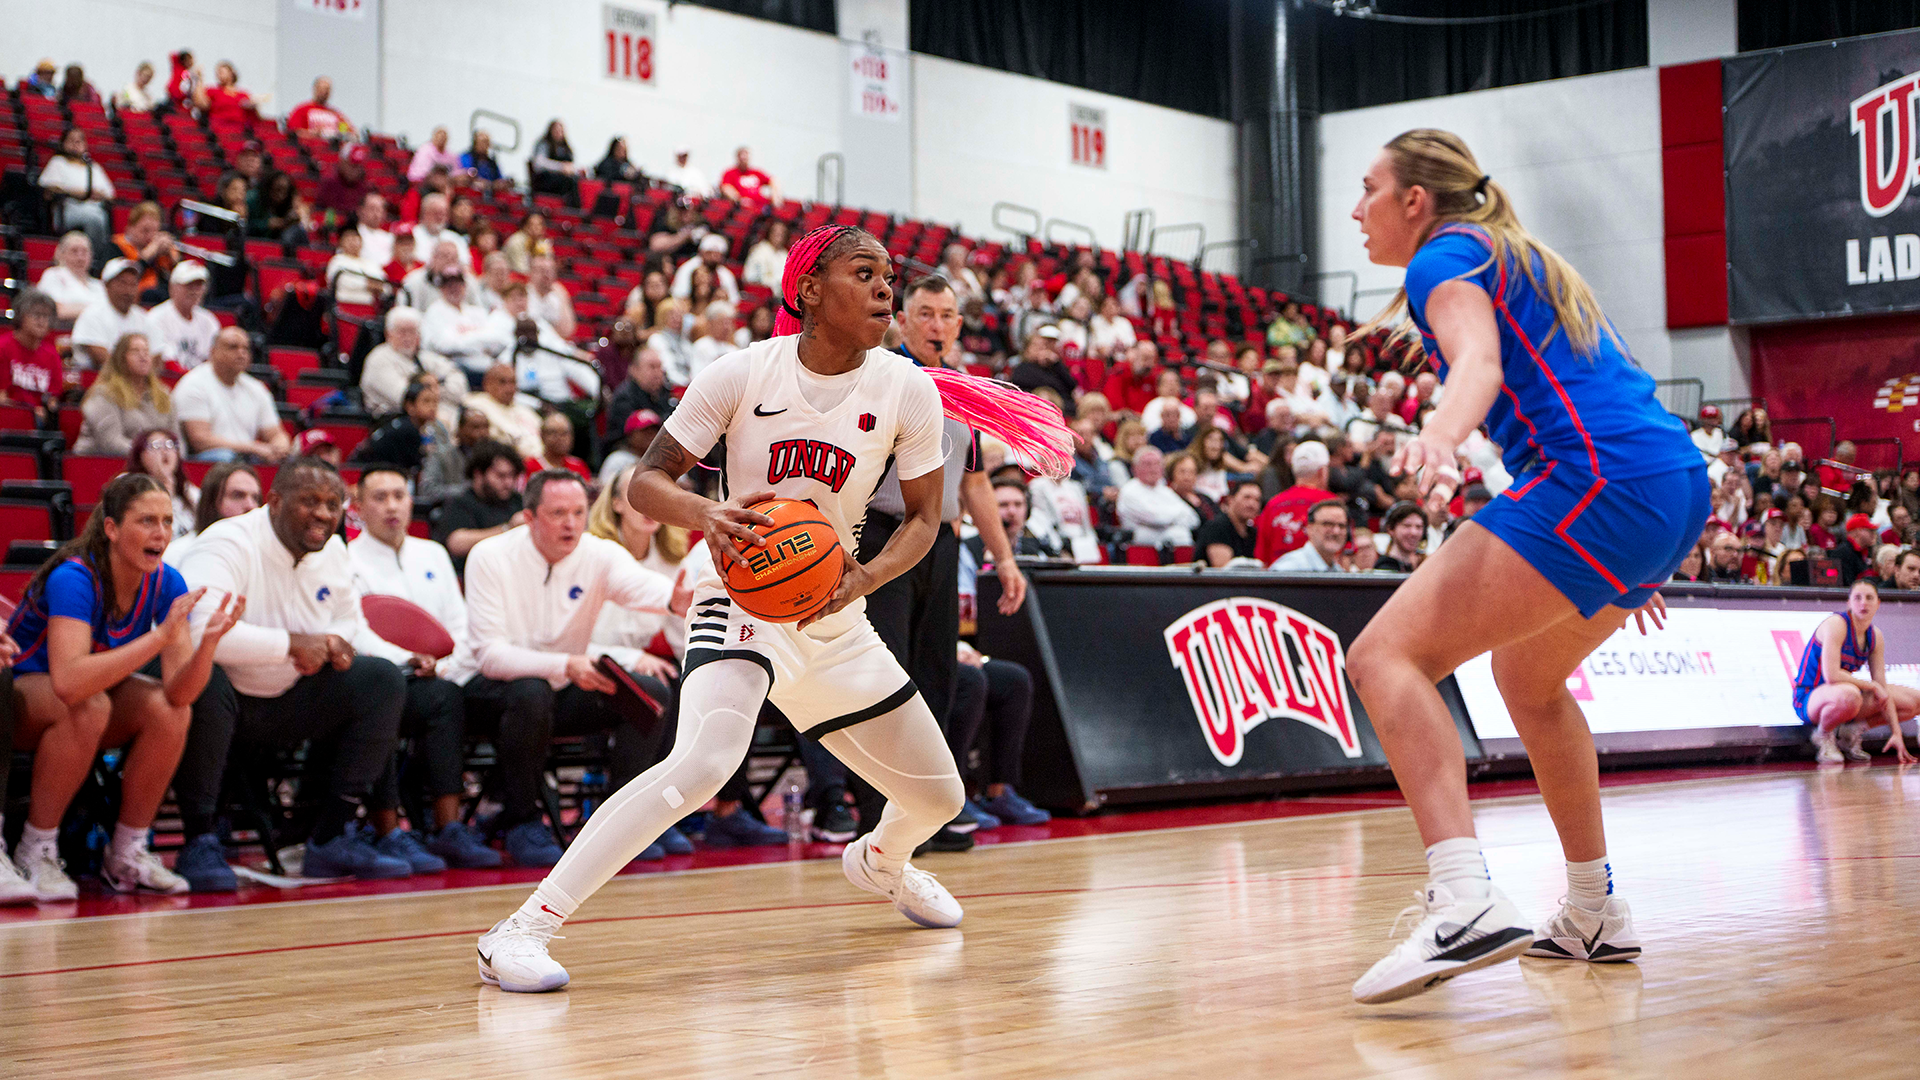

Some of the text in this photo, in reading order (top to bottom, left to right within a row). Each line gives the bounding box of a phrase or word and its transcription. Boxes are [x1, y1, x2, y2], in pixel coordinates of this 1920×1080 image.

[605, 30, 653, 81] 118
[1070, 123, 1105, 165] 119
[767, 439, 856, 493] UNLV
[747, 530, 816, 575] ELITE
[754, 548, 818, 581] CHAMPIONSHIP
[1163, 596, 1364, 768] UNLV
[1588, 651, 1627, 675] LES
